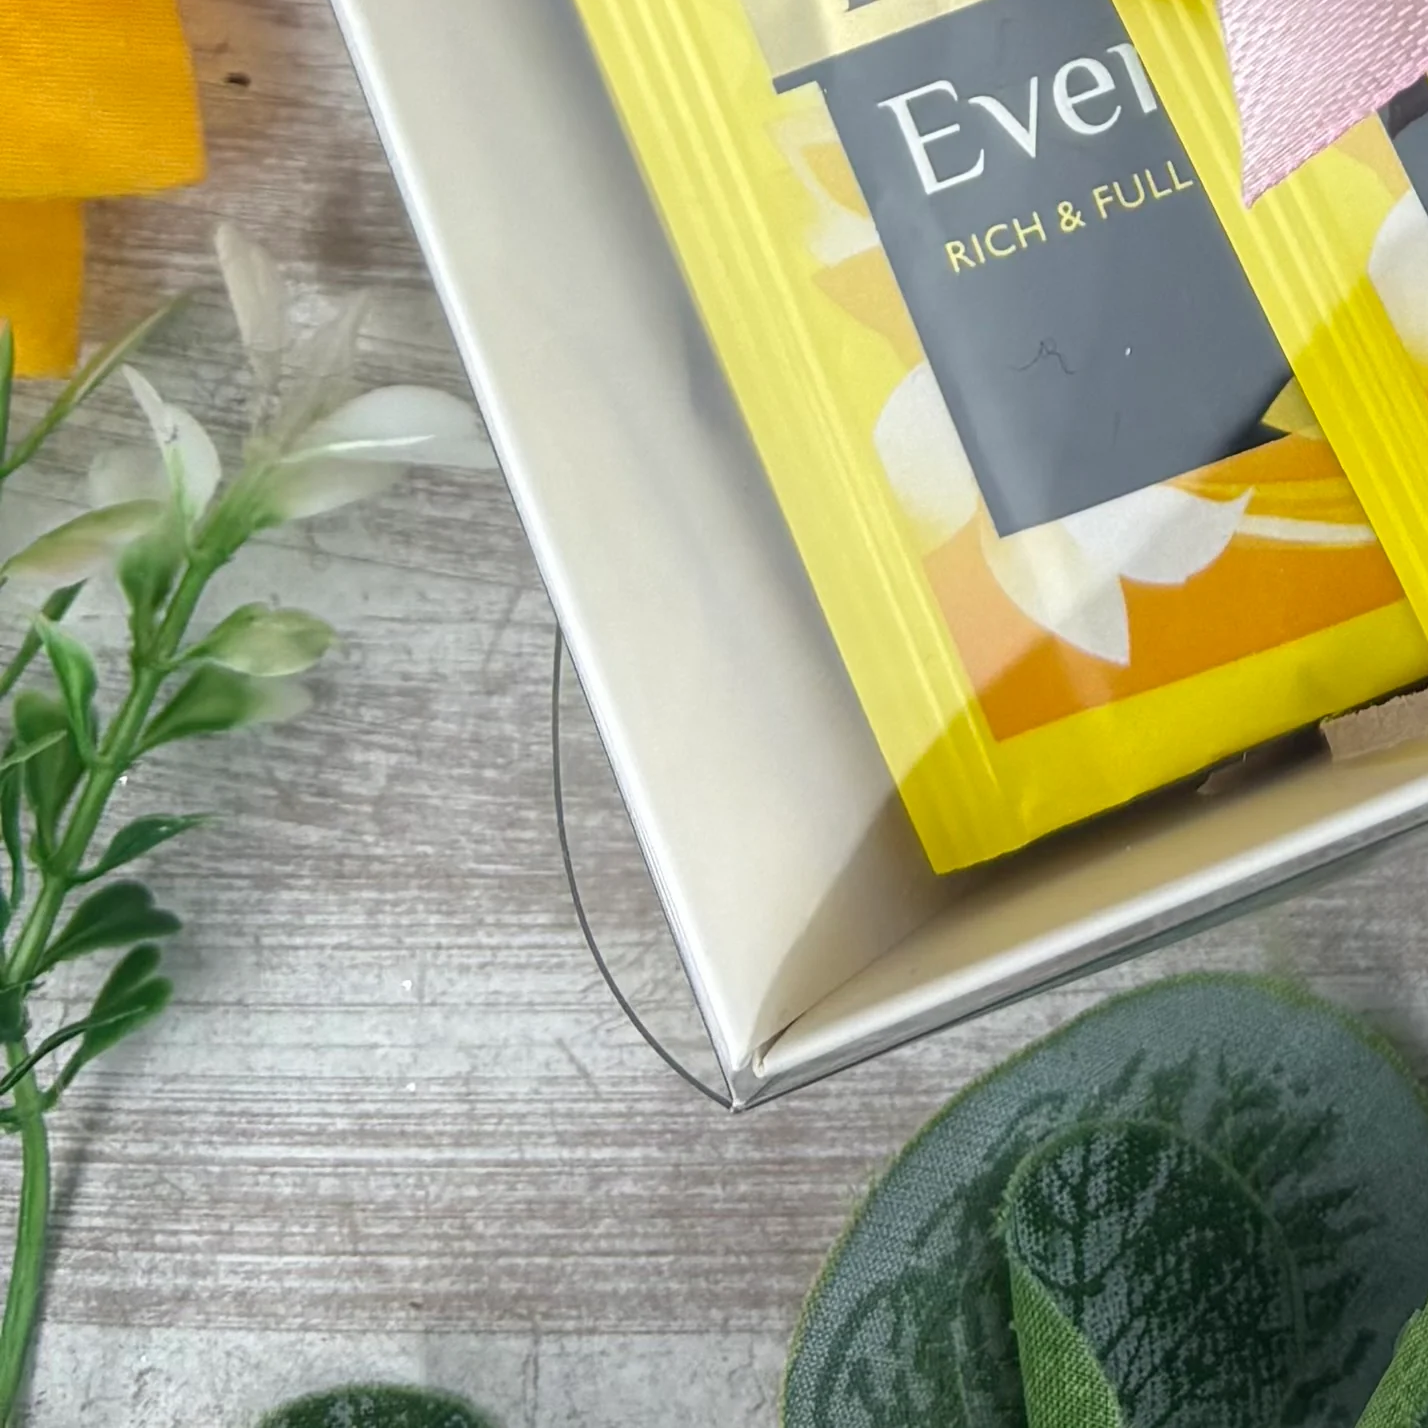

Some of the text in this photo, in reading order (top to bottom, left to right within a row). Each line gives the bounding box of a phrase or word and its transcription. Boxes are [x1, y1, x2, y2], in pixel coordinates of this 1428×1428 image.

[945, 160, 1194, 275] RICH & FULL
